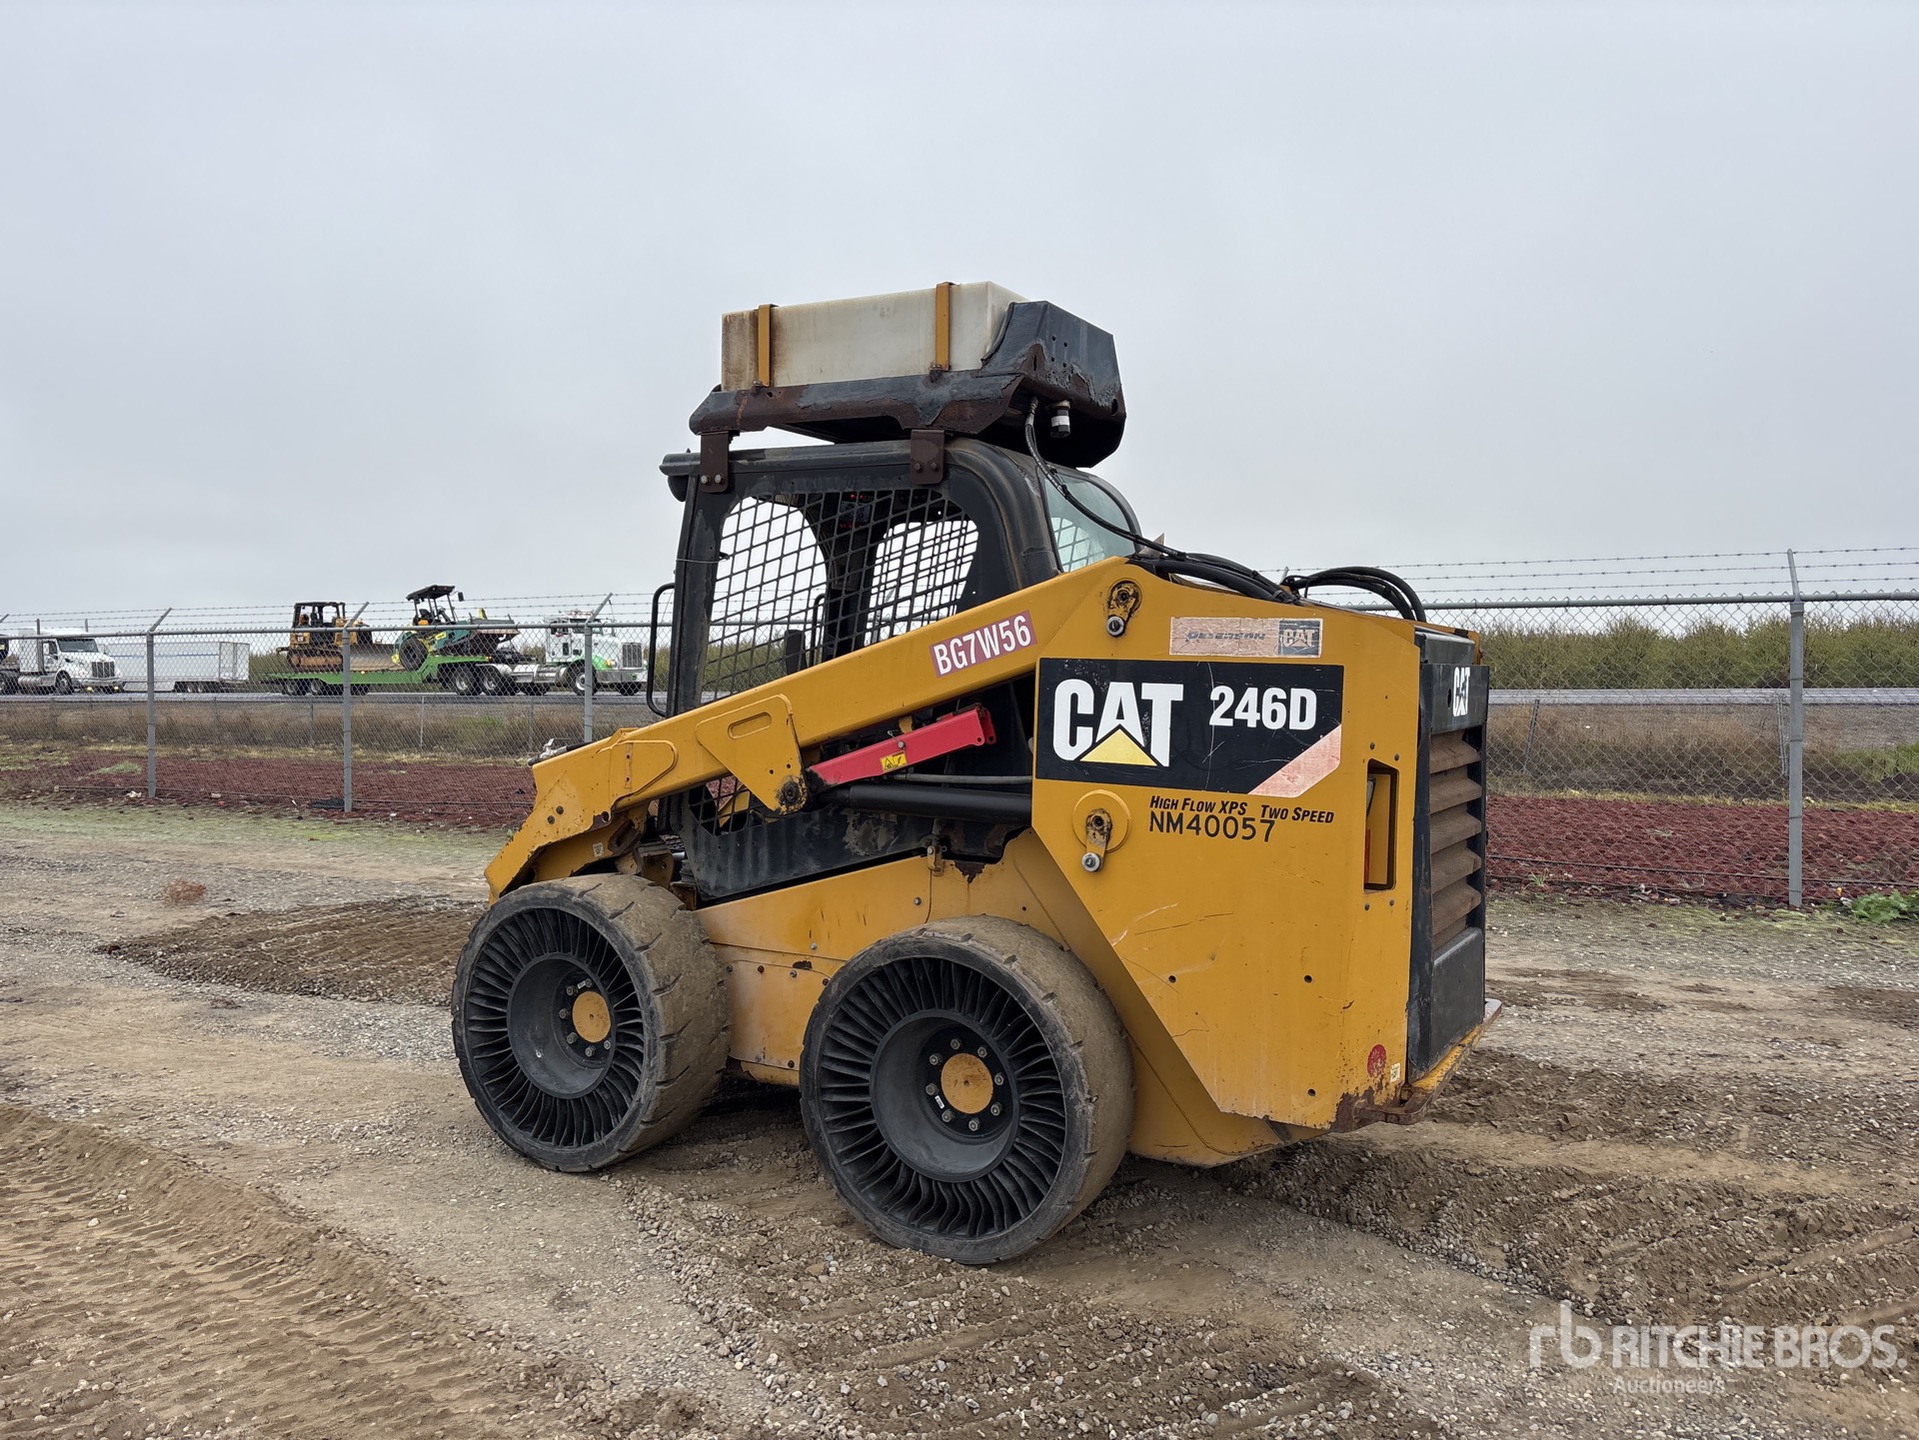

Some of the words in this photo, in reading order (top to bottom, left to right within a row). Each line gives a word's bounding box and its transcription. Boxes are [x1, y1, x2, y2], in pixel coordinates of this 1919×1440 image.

[933, 615, 1031, 675] BG7W56
[1283, 629, 1317, 648] CAT
[1053, 679, 1184, 767] CAT
[1209, 685, 1317, 730] 246D
[1150, 795, 1178, 810] HIGH
[1181, 798, 1216, 812] FLOW
[1218, 801, 1248, 815] XPS
[1261, 805, 1289, 820] TWO
[1292, 807, 1334, 823] SPEED
[1149, 811, 1275, 842] NM40057
